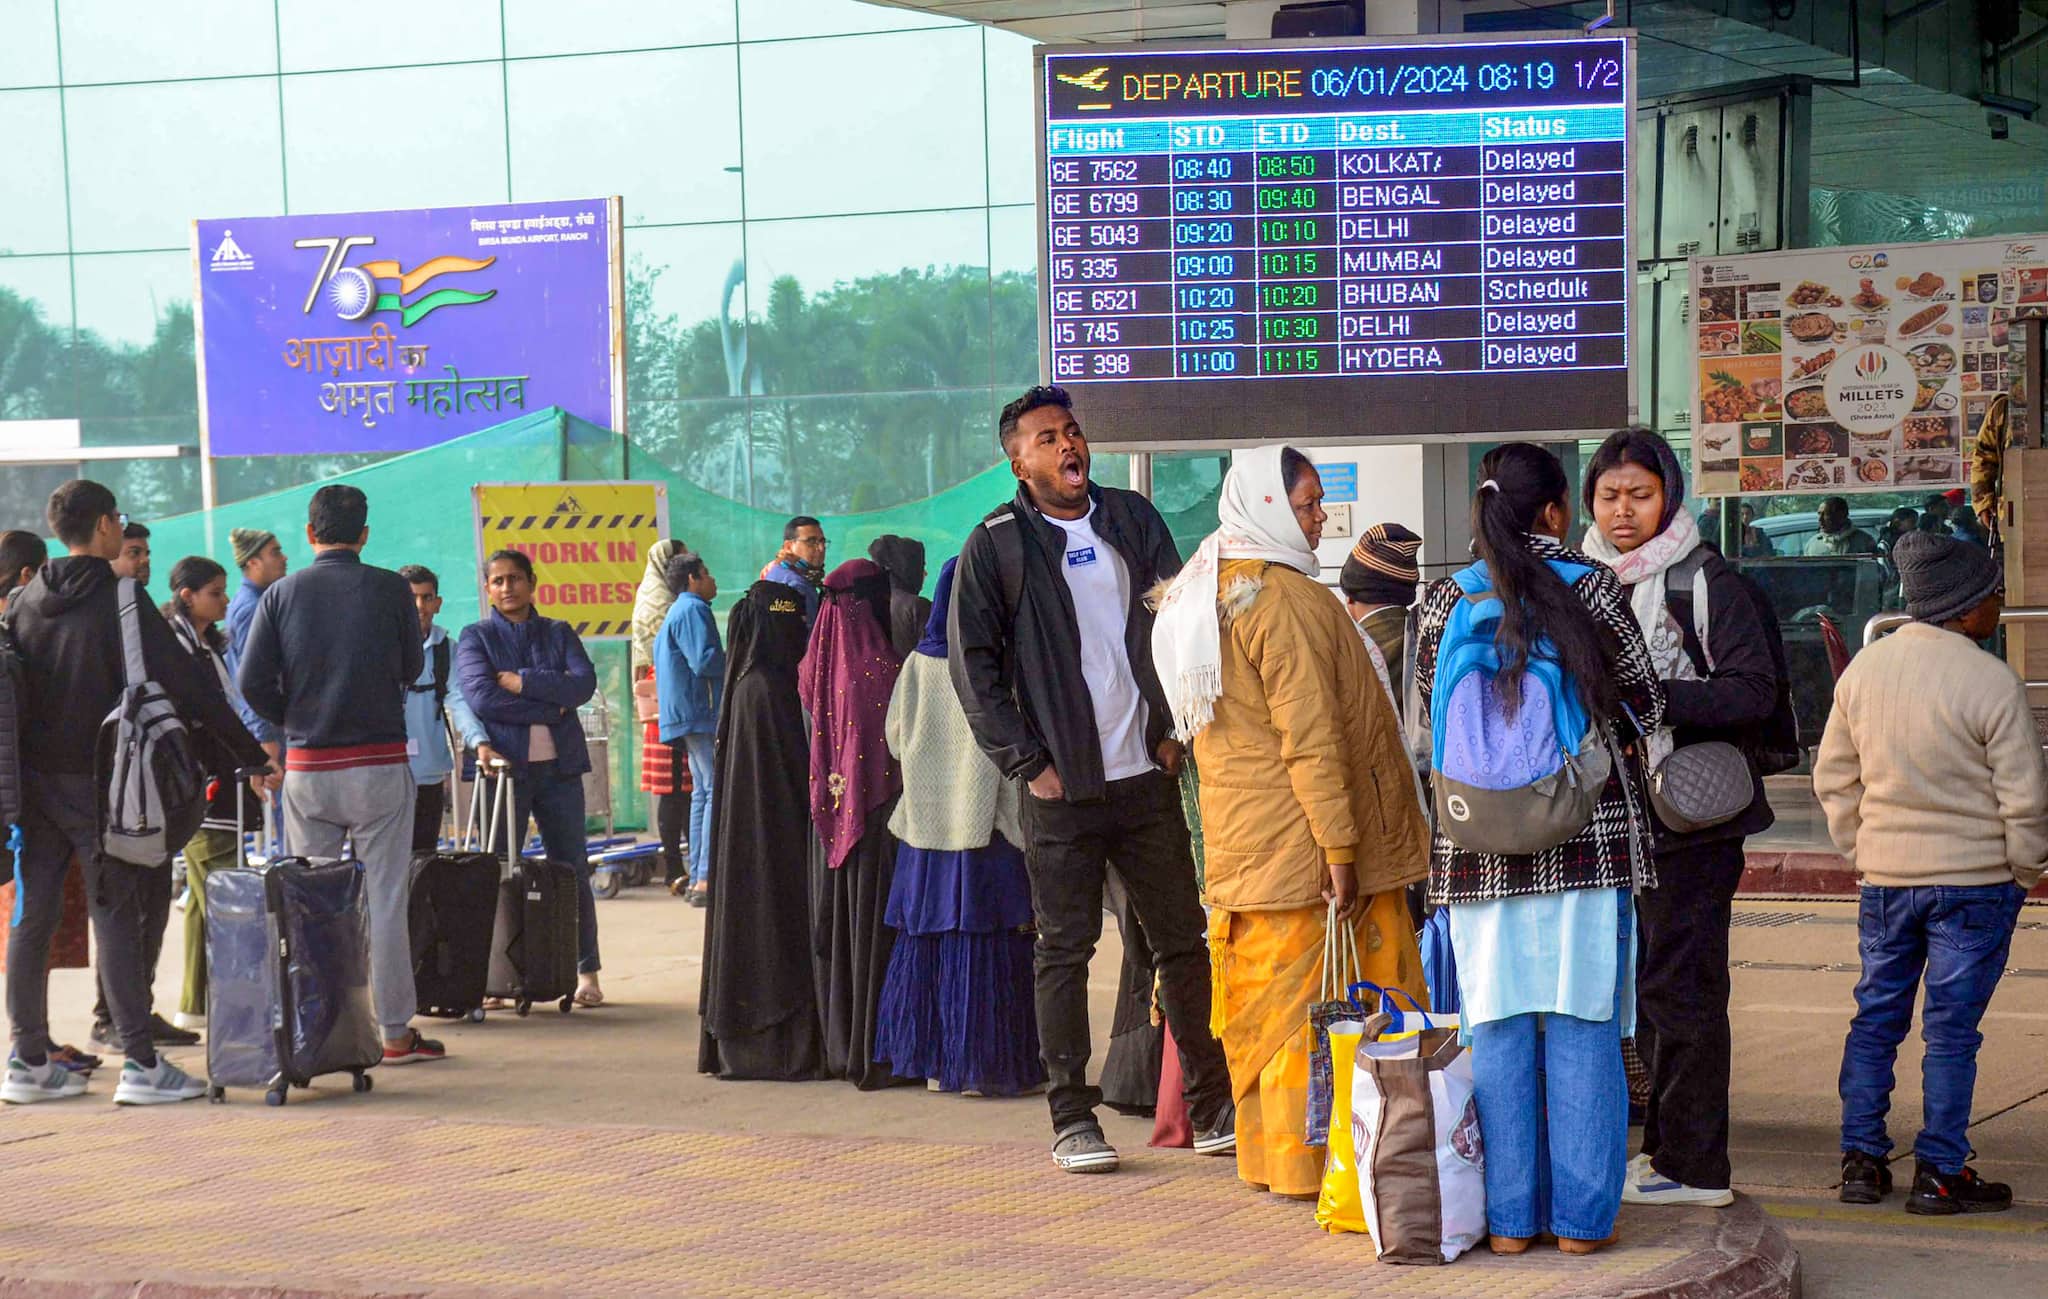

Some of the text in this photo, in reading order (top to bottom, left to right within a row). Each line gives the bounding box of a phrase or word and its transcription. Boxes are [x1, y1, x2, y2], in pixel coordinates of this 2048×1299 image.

[1123, 58, 1619, 100] DEPARTURE 06/01/2024 08:19 1/2
[1053, 116, 1568, 151] Flight STD ETD Dest. Status
[1053, 161, 1080, 182] 6E
[1089, 160, 1138, 181] 7562
[1174, 158, 1232, 179] 08:40
[1258, 155, 1316, 177] 08:50
[1485, 148, 1576, 172] Delayed
[1053, 180, 1576, 214] 6E 6799 08:30 09:40 BENGAL Delayed
[1054, 213, 1576, 247] 6E 5043 09:20 10:10 DELHI Delayed
[1081, 258, 1118, 279] 335
[1176, 255, 1234, 277] 09:00
[1262, 253, 1317, 275] 10:15
[1343, 249, 1441, 272] MUMBAI
[1486, 245, 1576, 269] Delayed
[1055, 291, 1083, 312] 6E
[1091, 290, 1137, 310] 6521
[1179, 287, 1234, 309] 10:20
[1263, 285, 1317, 307] 10:20
[1344, 281, 1440, 304] BHUBAN
[1082, 322, 1120, 343] 745
[1179, 319, 1235, 341] 10:25
[1263, 317, 1318, 340] 10:30
[1343, 315, 1410, 336] DELHI
[1486, 310, 1577, 334] Delayed
[282, 321, 430, 377] आज़ादी का
[1057, 342, 1577, 376] 6E 398 11:00 11:15 HYDERA Delayed
[318, 364, 530, 428] अमृत महोत्सव
[1839, 389, 1904, 402] MILLETS
[1856, 402, 1887, 413] 2023
[607, 540, 637, 563] IN
[533, 581, 640, 607] OGRES
